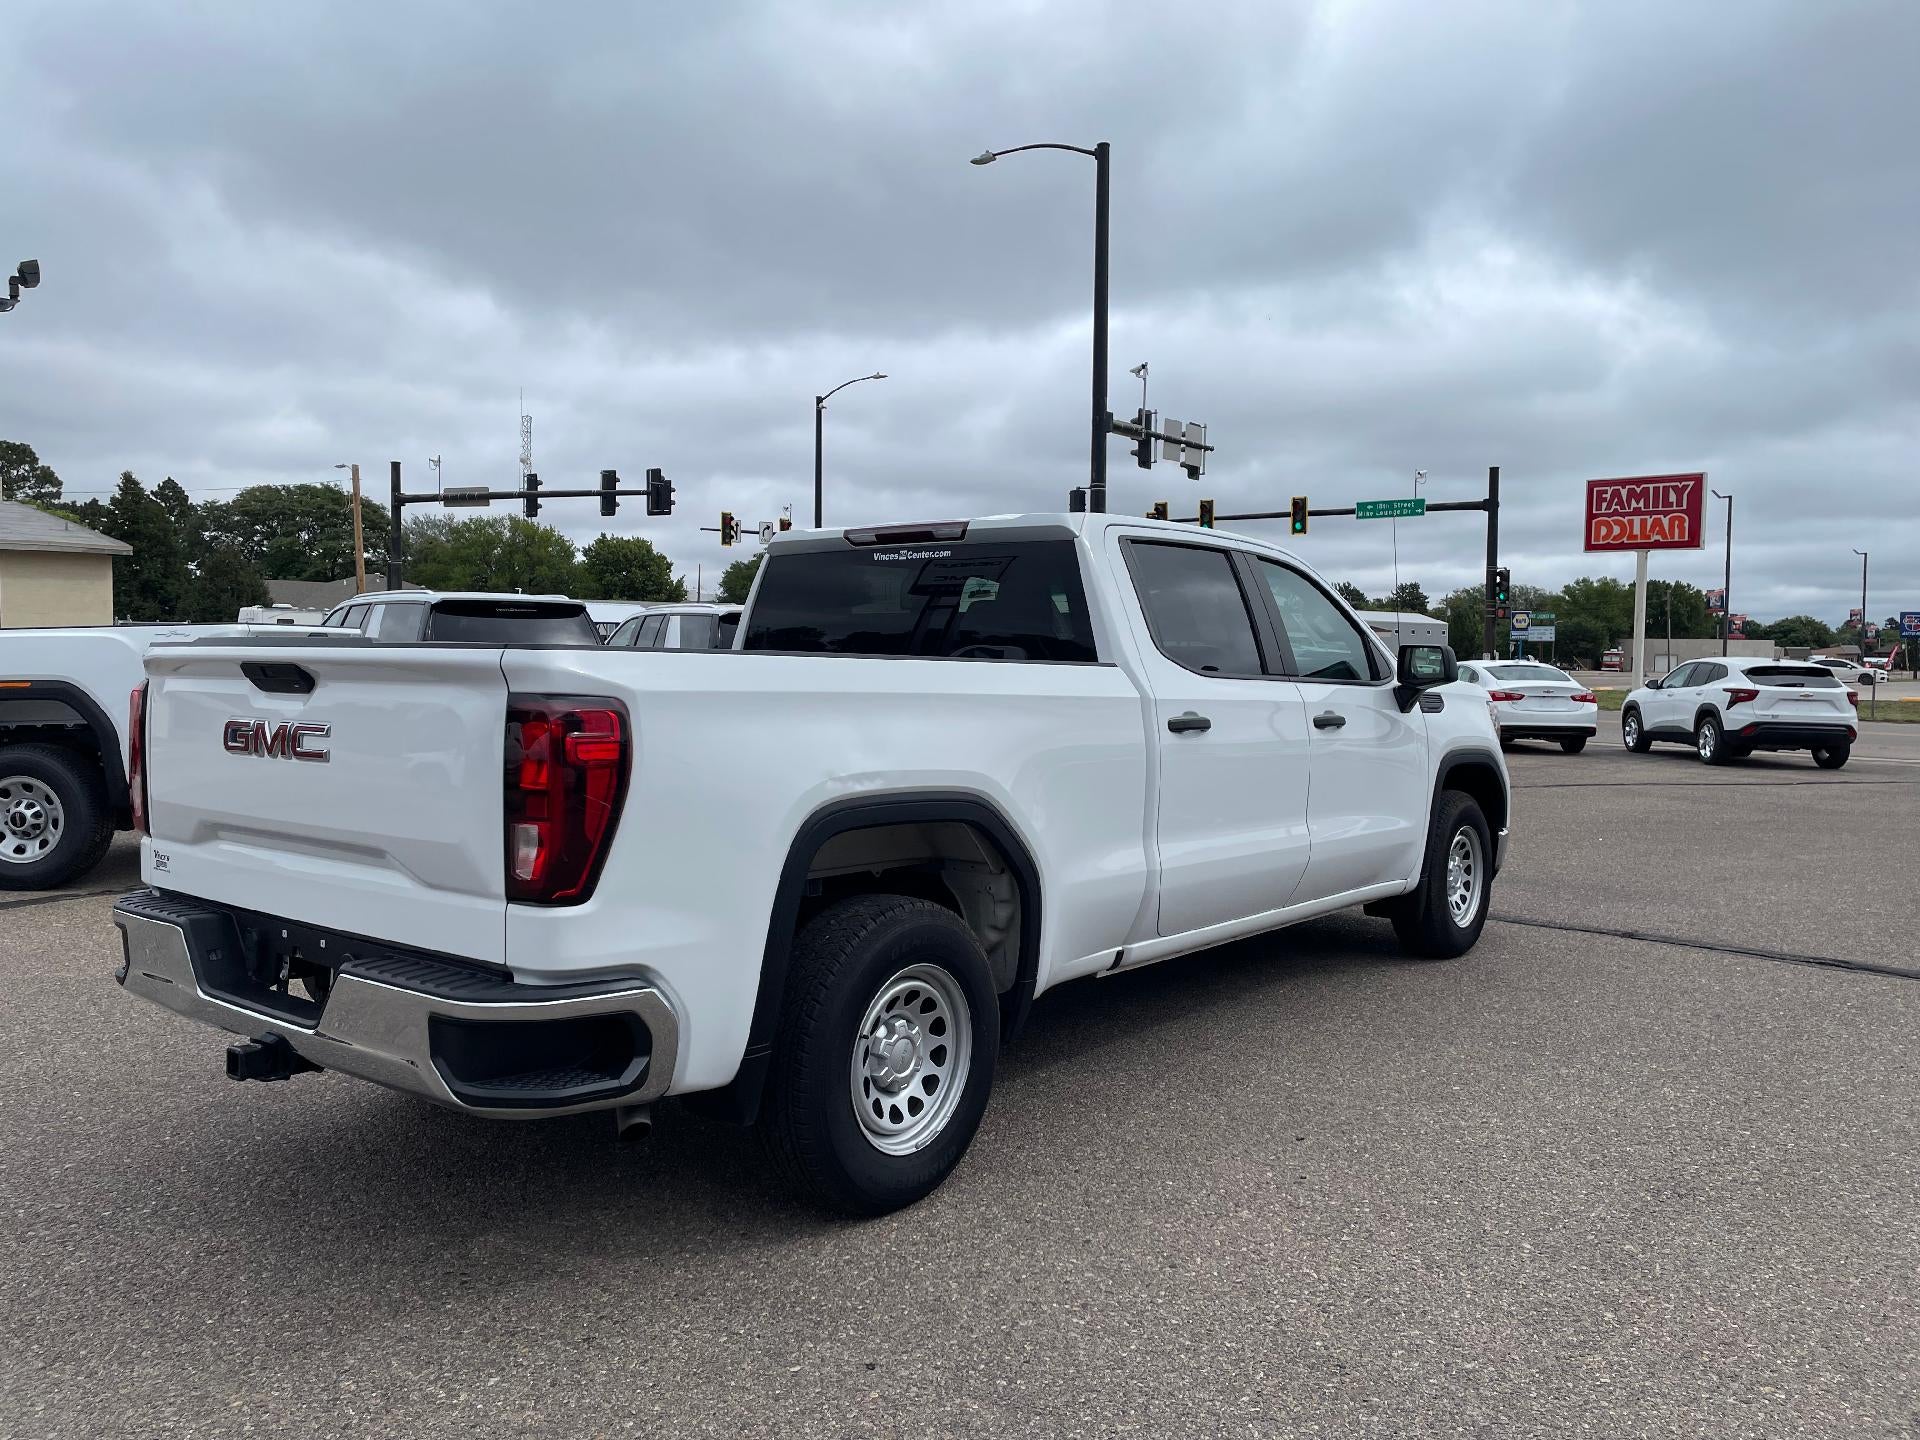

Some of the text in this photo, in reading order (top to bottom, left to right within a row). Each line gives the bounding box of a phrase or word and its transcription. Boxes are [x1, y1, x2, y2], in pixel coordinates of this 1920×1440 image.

[1593, 481, 1695, 513] FAMILY
[1592, 513, 1688, 544] DOLLAR
[223, 720, 331, 762] GMC
